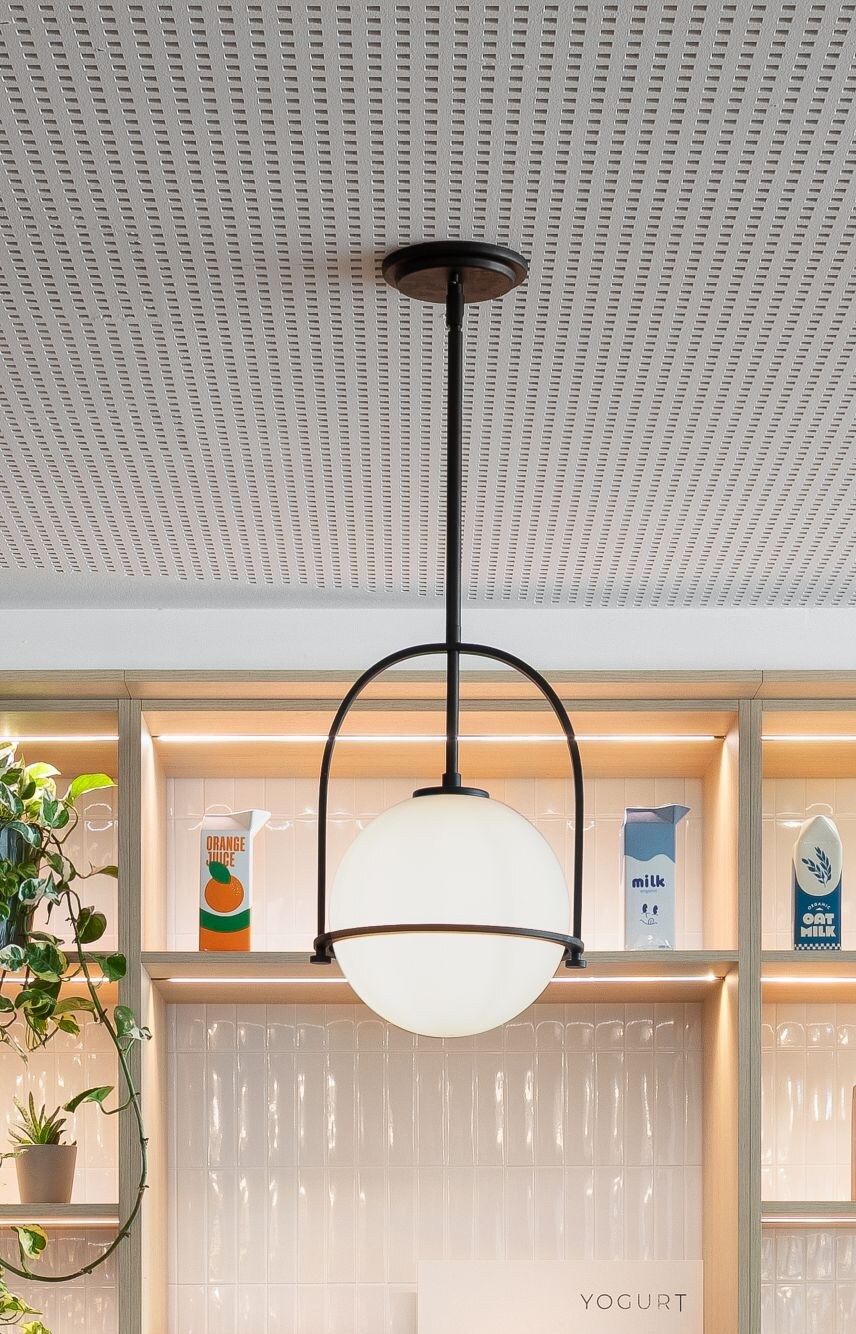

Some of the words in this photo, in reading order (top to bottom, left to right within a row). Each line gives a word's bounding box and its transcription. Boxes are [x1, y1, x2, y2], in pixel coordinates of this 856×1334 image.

[206, 835, 246, 852] ORANGE
[205, 851, 235, 867] JUICE
[632, 874, 666, 888] milk
[807, 902, 831, 911] ORGANIC
[802, 912, 835, 925] OAT
[800, 925, 837, 938] MILK
[580, 1293, 687, 1312] YOGURT
